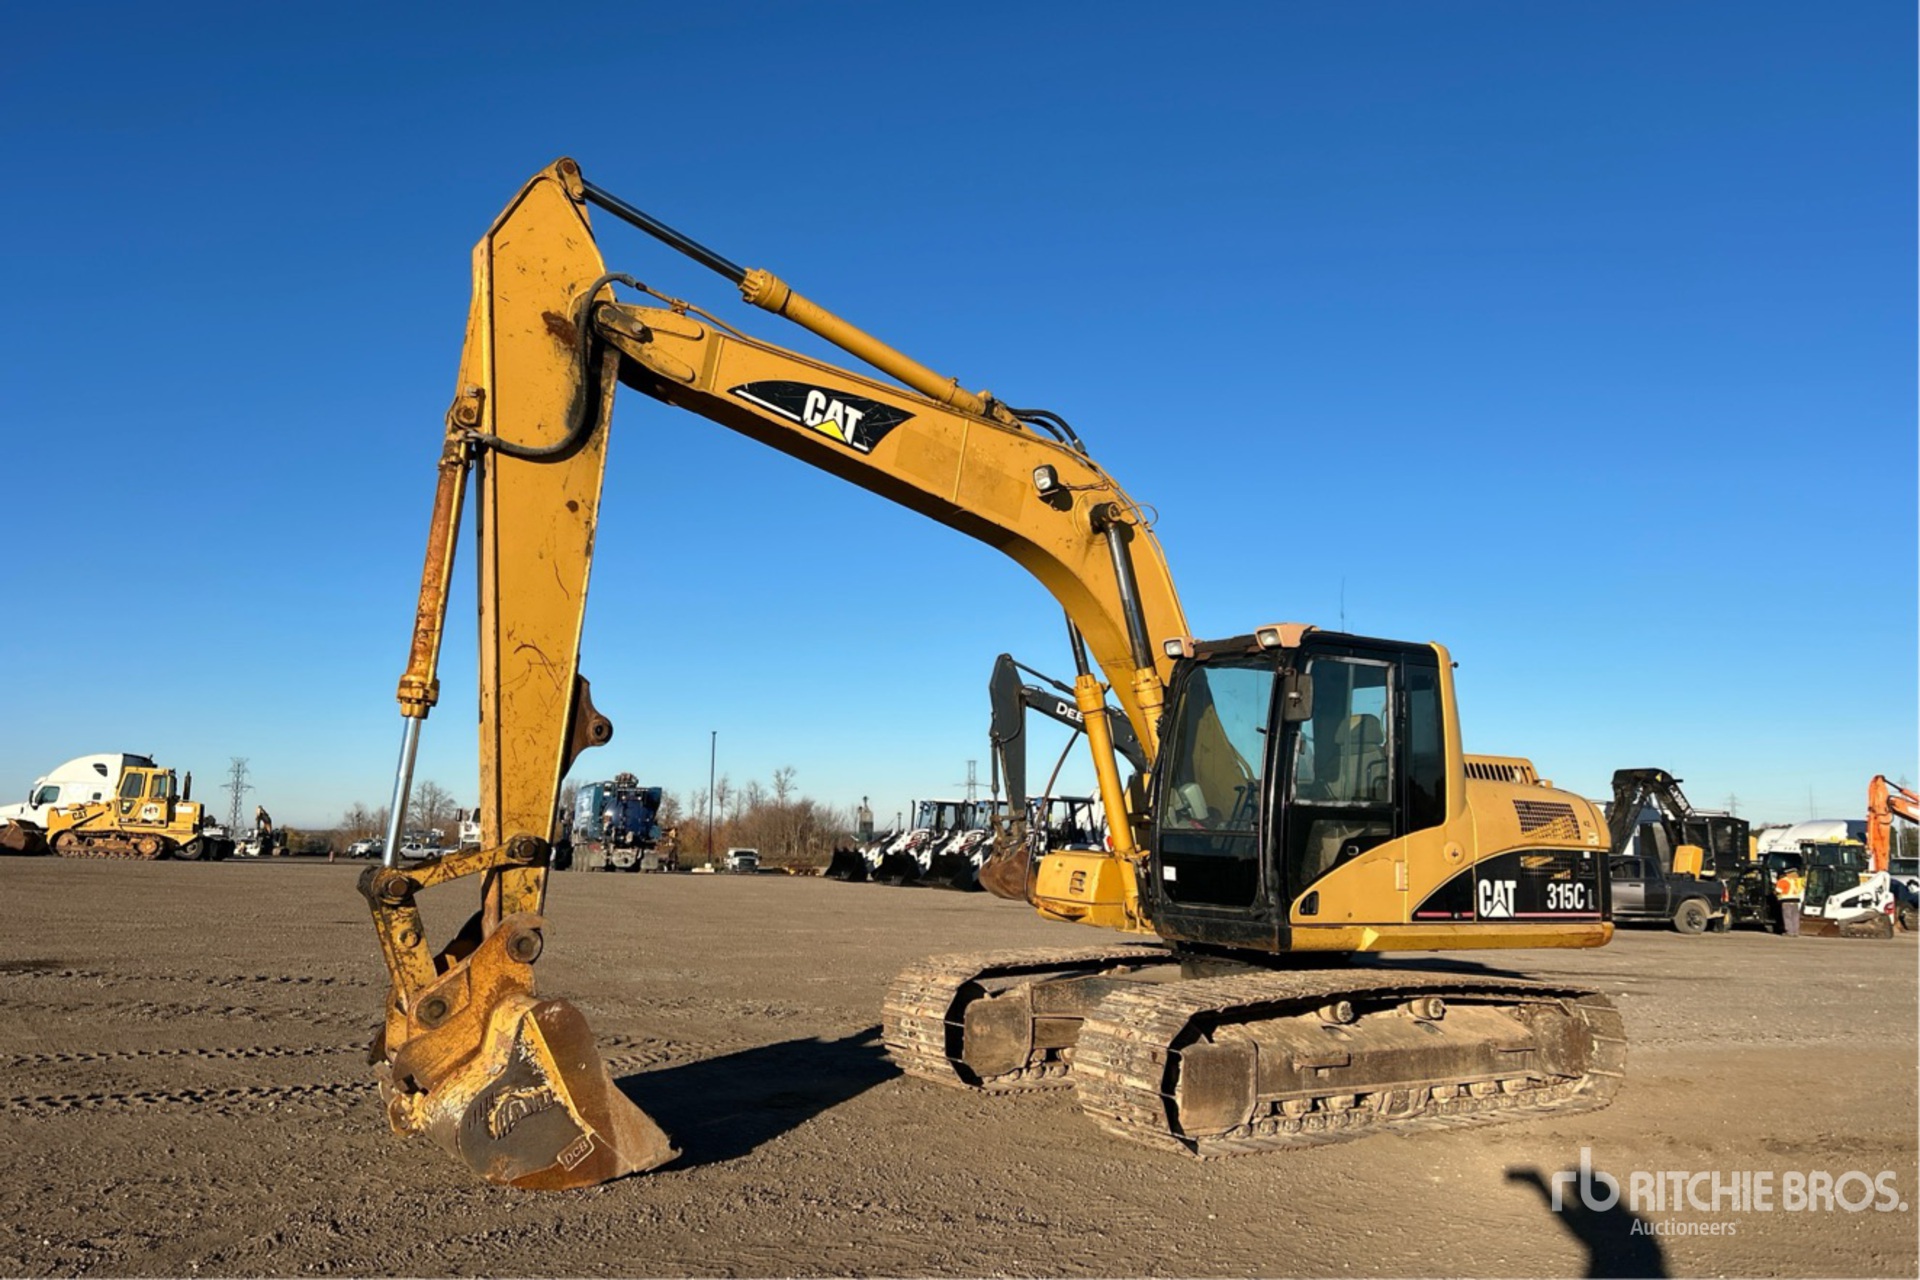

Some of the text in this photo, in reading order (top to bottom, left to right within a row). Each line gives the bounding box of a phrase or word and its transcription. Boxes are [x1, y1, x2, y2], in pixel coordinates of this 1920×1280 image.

[803, 389, 864, 445] CAT
[1056, 701, 1084, 723] DEE
[1478, 879, 1517, 918] CAT
[1546, 882, 1585, 910] 315C
